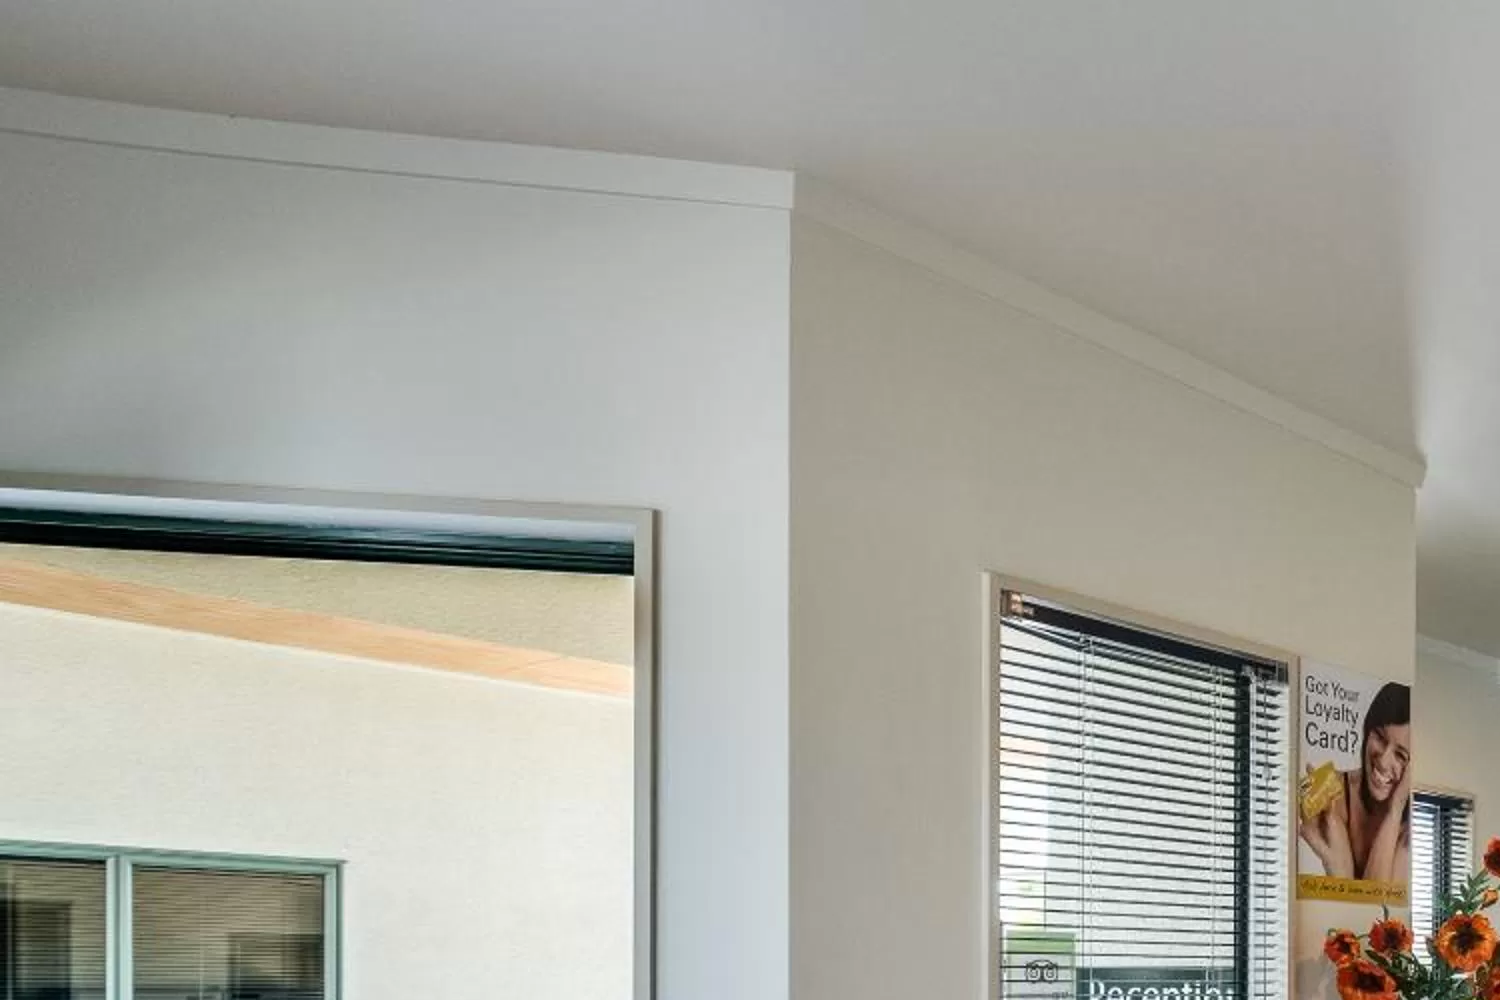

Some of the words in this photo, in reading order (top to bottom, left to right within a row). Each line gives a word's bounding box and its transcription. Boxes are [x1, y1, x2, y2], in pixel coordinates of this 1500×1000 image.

[1305, 675, 1328, 696] Got
[1305, 695, 1359, 728] Loyalty
[1305, 721, 1359, 754] Card?
